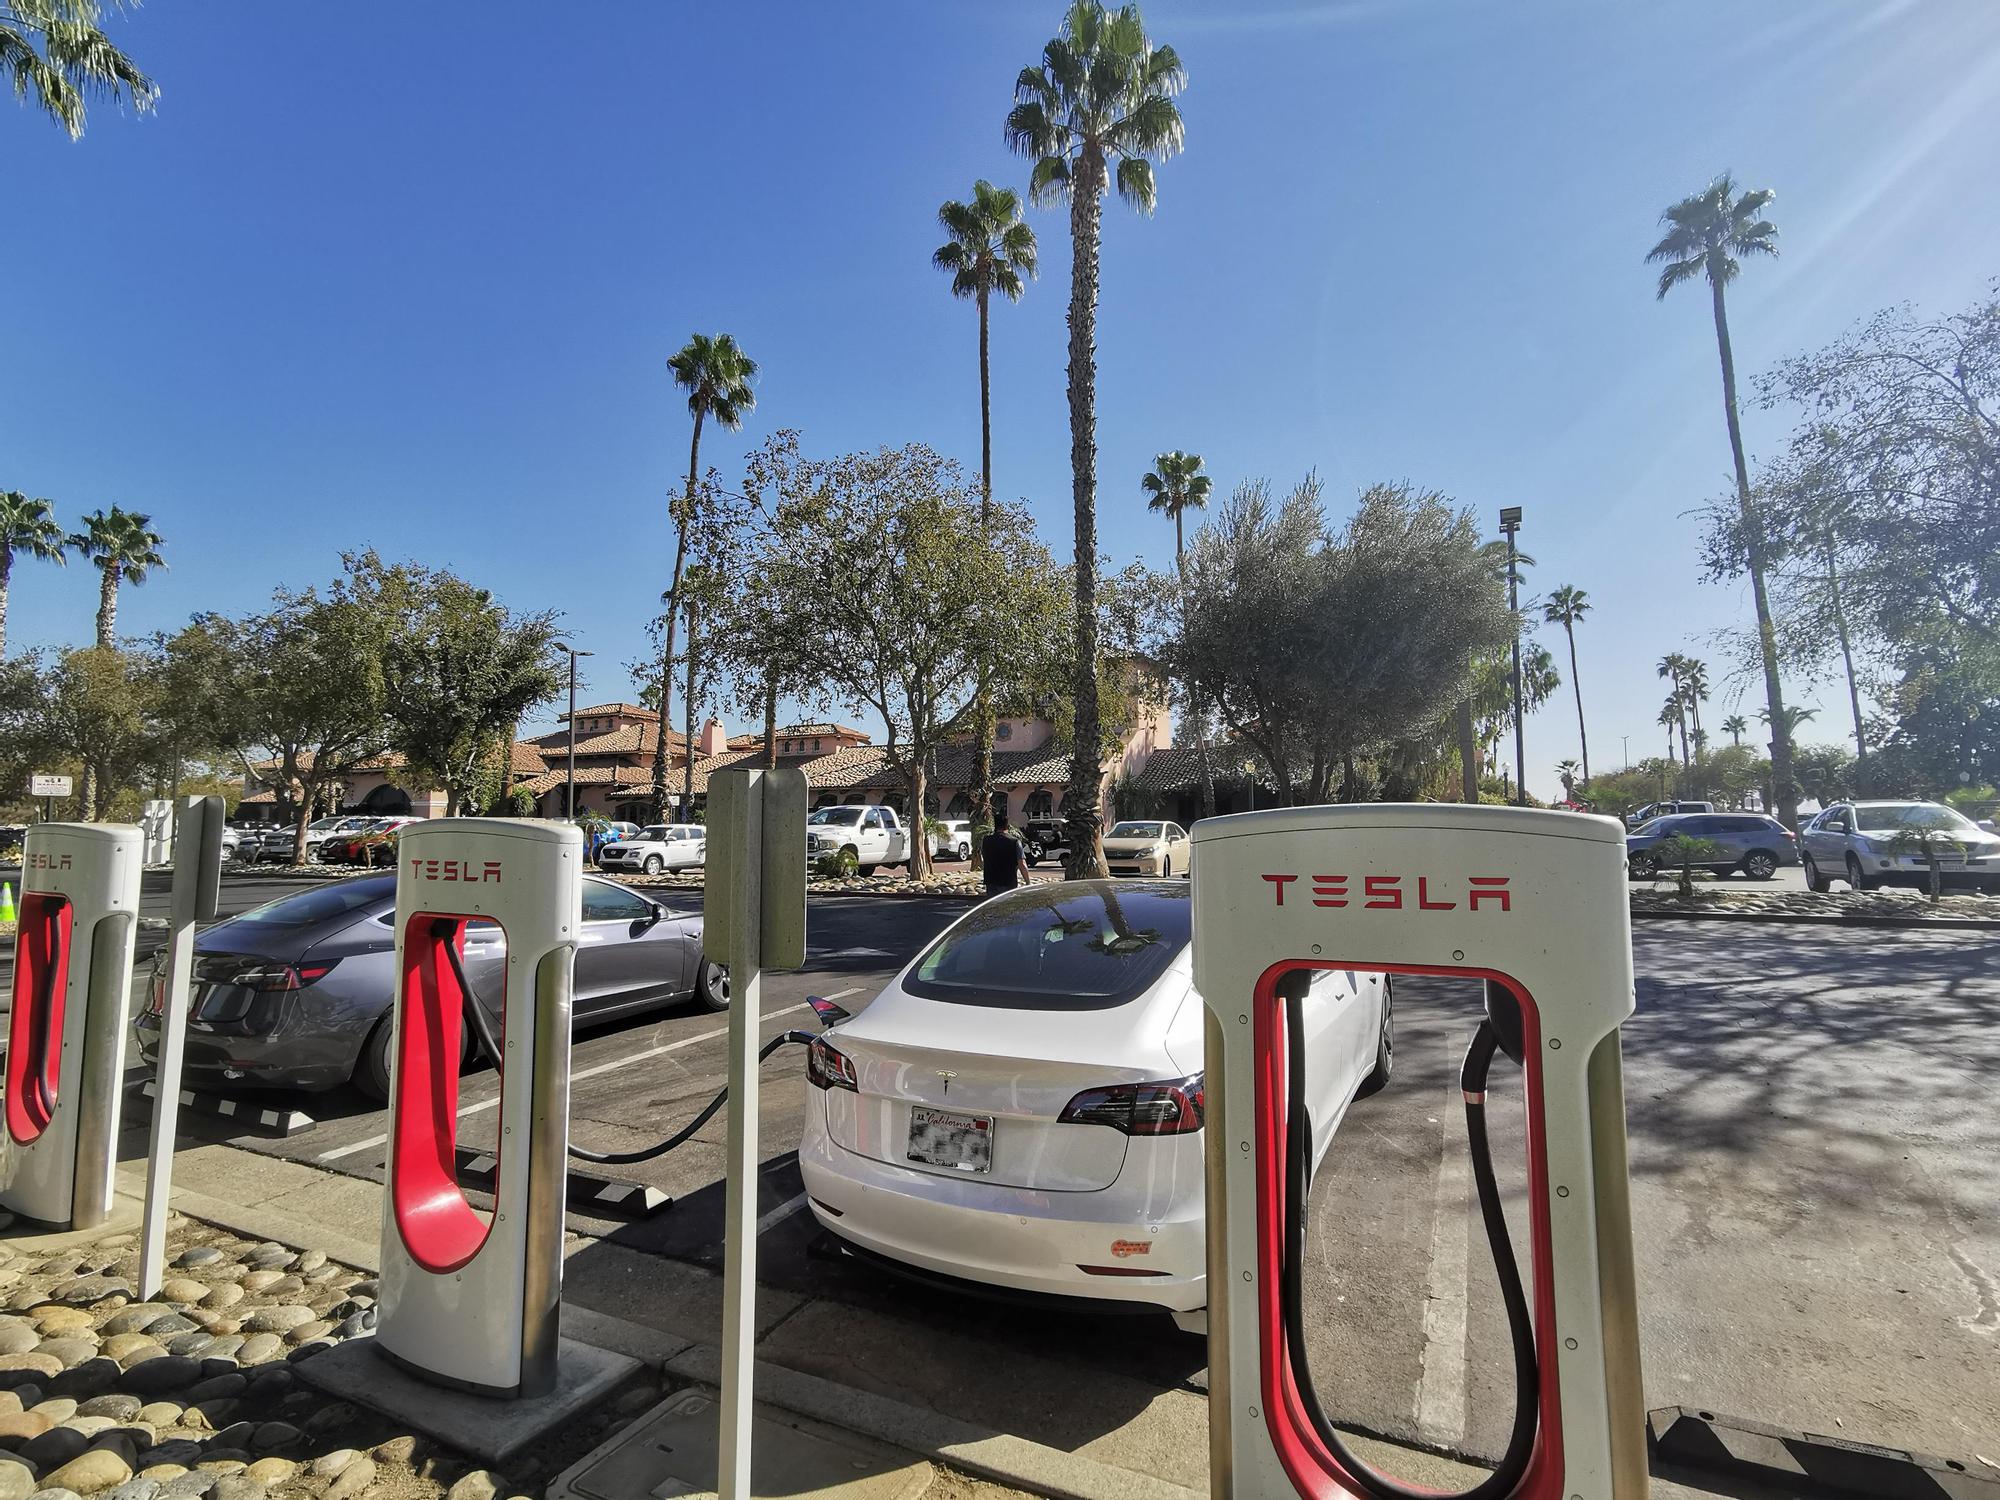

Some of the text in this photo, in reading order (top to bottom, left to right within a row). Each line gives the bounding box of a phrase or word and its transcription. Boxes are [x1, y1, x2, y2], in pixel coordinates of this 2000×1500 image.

[27, 854, 73, 870] ESLA
[411, 860, 501, 883] TESLA
[1261, 874, 1511, 912] TESLA
[927, 1112, 975, 1130] California
